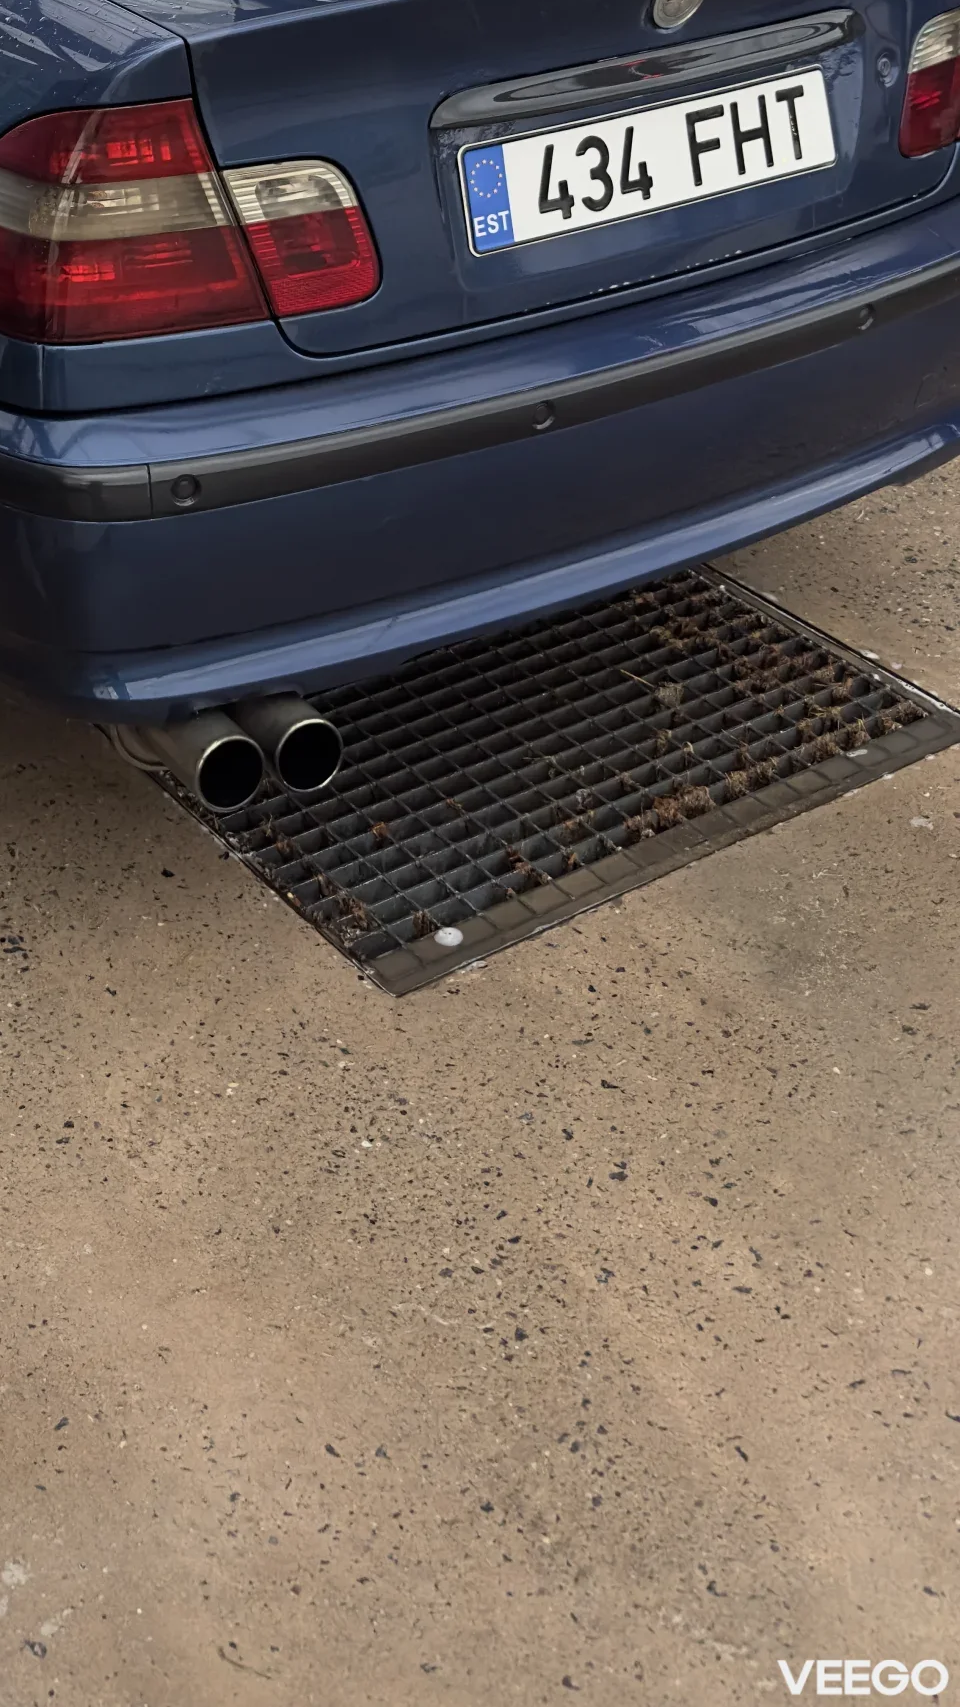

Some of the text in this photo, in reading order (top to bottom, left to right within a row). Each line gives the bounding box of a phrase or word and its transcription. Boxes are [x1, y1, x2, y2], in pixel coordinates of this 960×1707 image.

[538, 85, 804, 219] 434 FHT
[474, 210, 510, 238] EST
